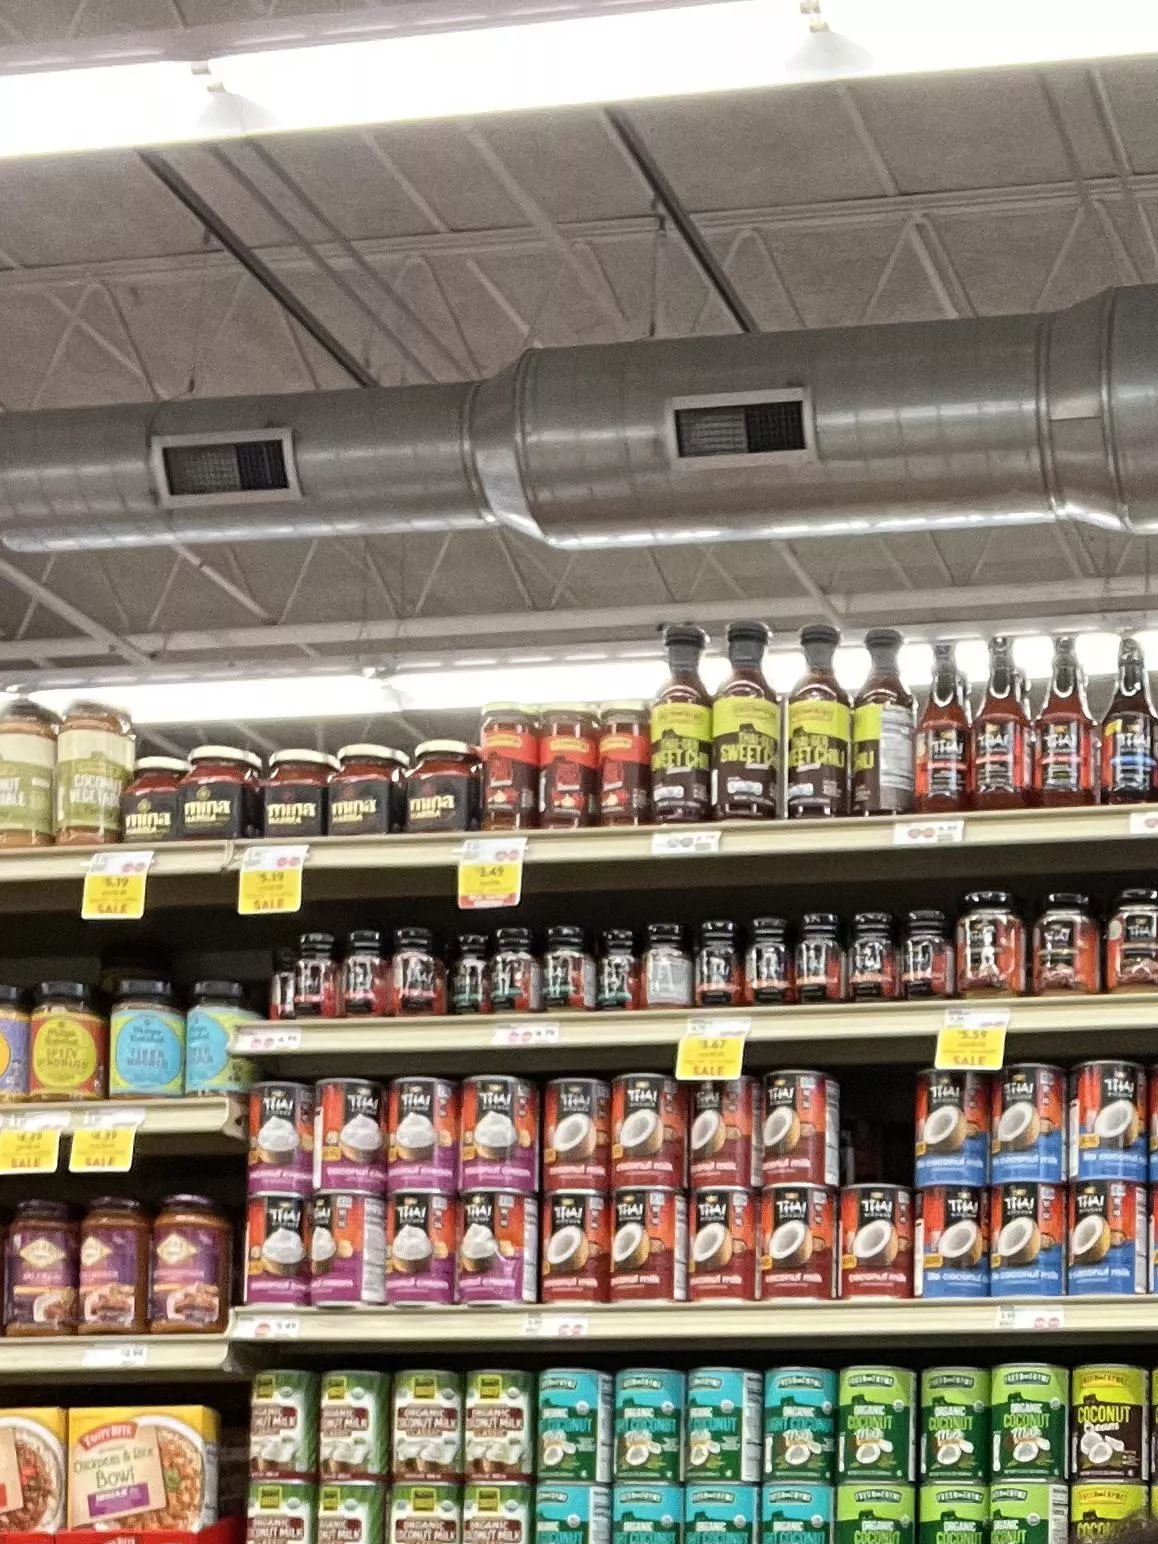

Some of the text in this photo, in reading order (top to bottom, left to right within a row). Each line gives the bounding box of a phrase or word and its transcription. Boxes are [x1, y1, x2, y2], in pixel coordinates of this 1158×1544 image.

[692, 1066, 726, 1077] SALE
[847, 1414, 893, 1431] COCONUT
[1004, 1413, 1050, 1429] COCONUT
[1078, 1406, 1131, 1423] COCONUT
[929, 1416, 973, 1432] COCONUT
